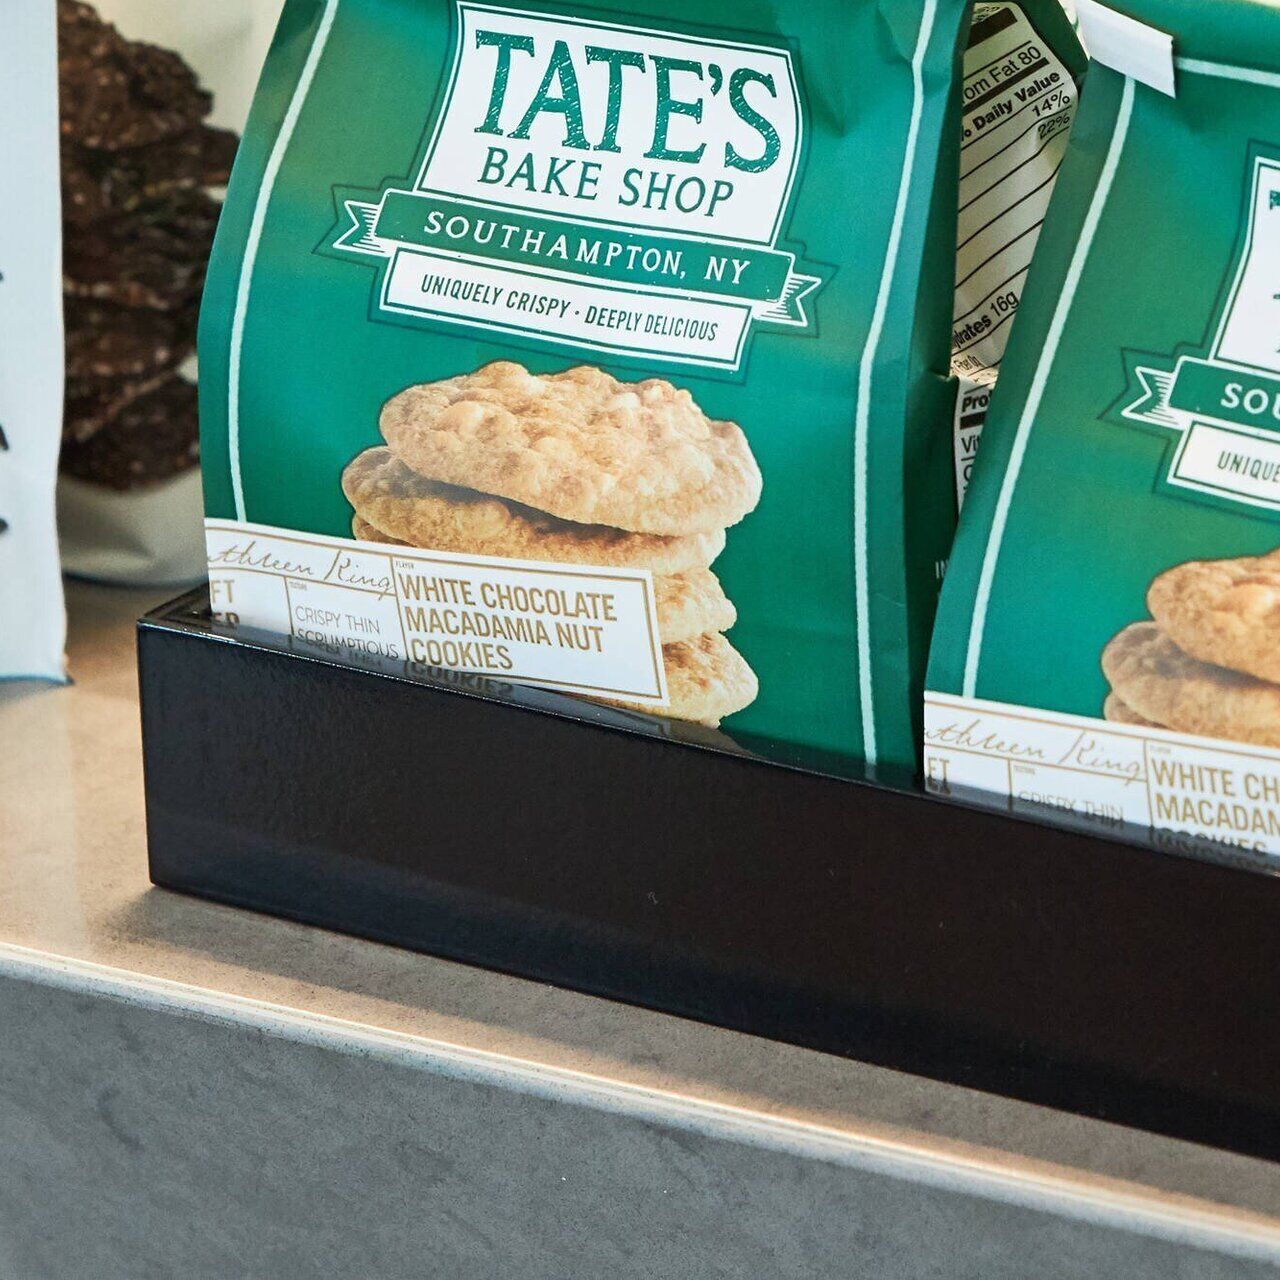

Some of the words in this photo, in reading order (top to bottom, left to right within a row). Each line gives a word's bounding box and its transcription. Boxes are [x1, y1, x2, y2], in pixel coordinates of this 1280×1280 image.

[962, 77, 991, 103] om
[989, 59, 1020, 83] Fat
[1018, 46, 1041, 66] 80
[473, 29, 782, 174] TATE'S
[972, 100, 1013, 130] Daily
[1014, 72, 1060, 102] Value
[1032, 90, 1070, 117] 14%
[1038, 112, 1070, 139] 22%
[478, 146, 603, 201] BAKE
[618, 168, 734, 218] SHOP
[423, 211, 687, 281] SOUTHAMPTON,
[705, 255, 752, 286] NY
[420, 274, 503, 306] UNIQUELY
[506, 290, 571, 319] CRISPY
[584, 305, 643, 330] DEEPLY
[644, 313, 718, 342] DELICIOUS
[990, 291, 1020, 317] 16g
[961, 389, 992, 412] Pro
[324, 549, 393, 601] King
[398, 573, 476, 606] WHITE
[479, 582, 618, 622] CHOCOLATE
[294, 606, 340, 628] CRISPY
[345, 614, 381, 634] THIN
[404, 606, 553, 646] MACADAMIA
[555, 622, 604, 653] NUT
[411, 638, 513, 670] COOKIES
[1059, 730, 1141, 787] King
[1151, 758, 1236, 797] WHITE
